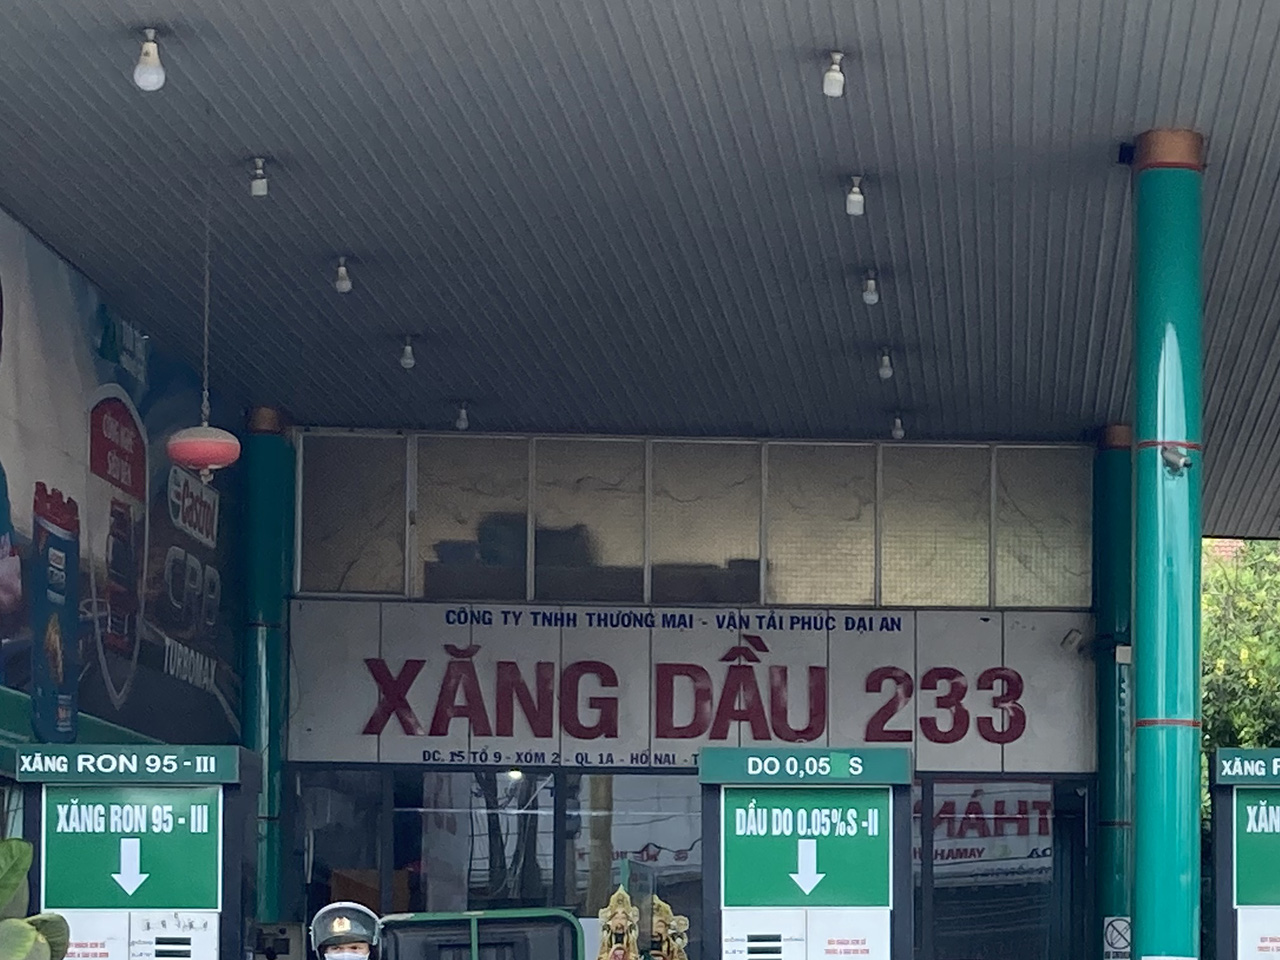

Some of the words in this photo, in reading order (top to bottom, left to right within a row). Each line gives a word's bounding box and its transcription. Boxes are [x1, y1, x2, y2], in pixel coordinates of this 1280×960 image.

[445, 607, 493, 625] CÔNG
[501, 611, 523, 626] TY
[530, 611, 577, 627] TNHH
[585, 611, 655, 628] THƯƠNG
[661, 613, 693, 632] MẠI
[715, 612, 749, 632] VẬN
[755, 610, 784, 630] TẢI
[789, 613, 836, 631] PHÚC
[844, 616, 873, 634] ĐẠI
[879, 616, 902, 632] AN
[164, 636, 217, 692] TURBOMAX
[362, 644, 619, 738] XĂNG
[655, 634, 828, 742] DẦU
[864, 665, 1027, 744] 233
[20, 752, 68, 773] XĂNG
[77, 754, 138, 773] RON
[145, 754, 178, 773] 95
[195, 756, 216, 773] III
[493, 751, 502, 763] 9
[515, 749, 552, 763] XÓM
[551, 752, 560, 764] 2
[575, 753, 592, 765] QL
[598, 753, 614, 765] 1A
[654, 752, 676, 765] NAI
[748, 757, 780, 775] DO
[785, 757, 831, 778] 0,05
[849, 757, 863, 775] S
[1221, 757, 1266, 776] XĂNG
[56, 798, 105, 833] XĂNG
[109, 804, 147, 833] RON
[151, 804, 174, 833] 95
[190, 804, 209, 833] III
[735, 798, 767, 836] DẦU
[772, 808, 793, 836] DO
